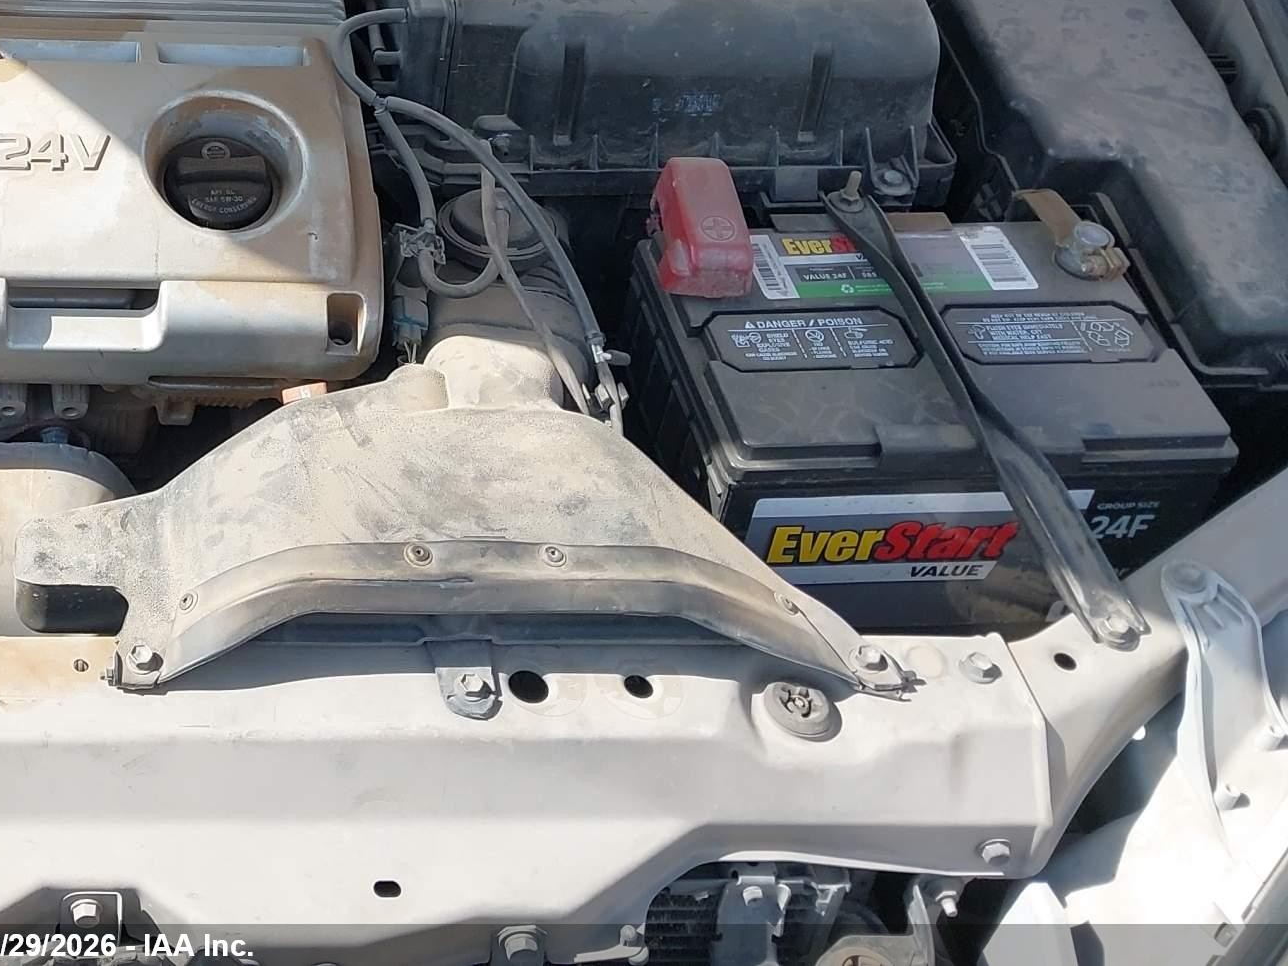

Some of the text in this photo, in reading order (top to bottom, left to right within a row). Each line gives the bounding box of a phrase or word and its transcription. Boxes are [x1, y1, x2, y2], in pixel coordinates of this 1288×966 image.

[782, 236, 857, 255] EverSt
[757, 319, 807, 329] DANGER
[817, 317, 864, 327] POISON
[1096, 500, 1161, 511] GROUP SIZE
[1090, 514, 1156, 540] 24F
[765, 520, 1020, 565] EverStart
[910, 564, 984, 578] VALUE
